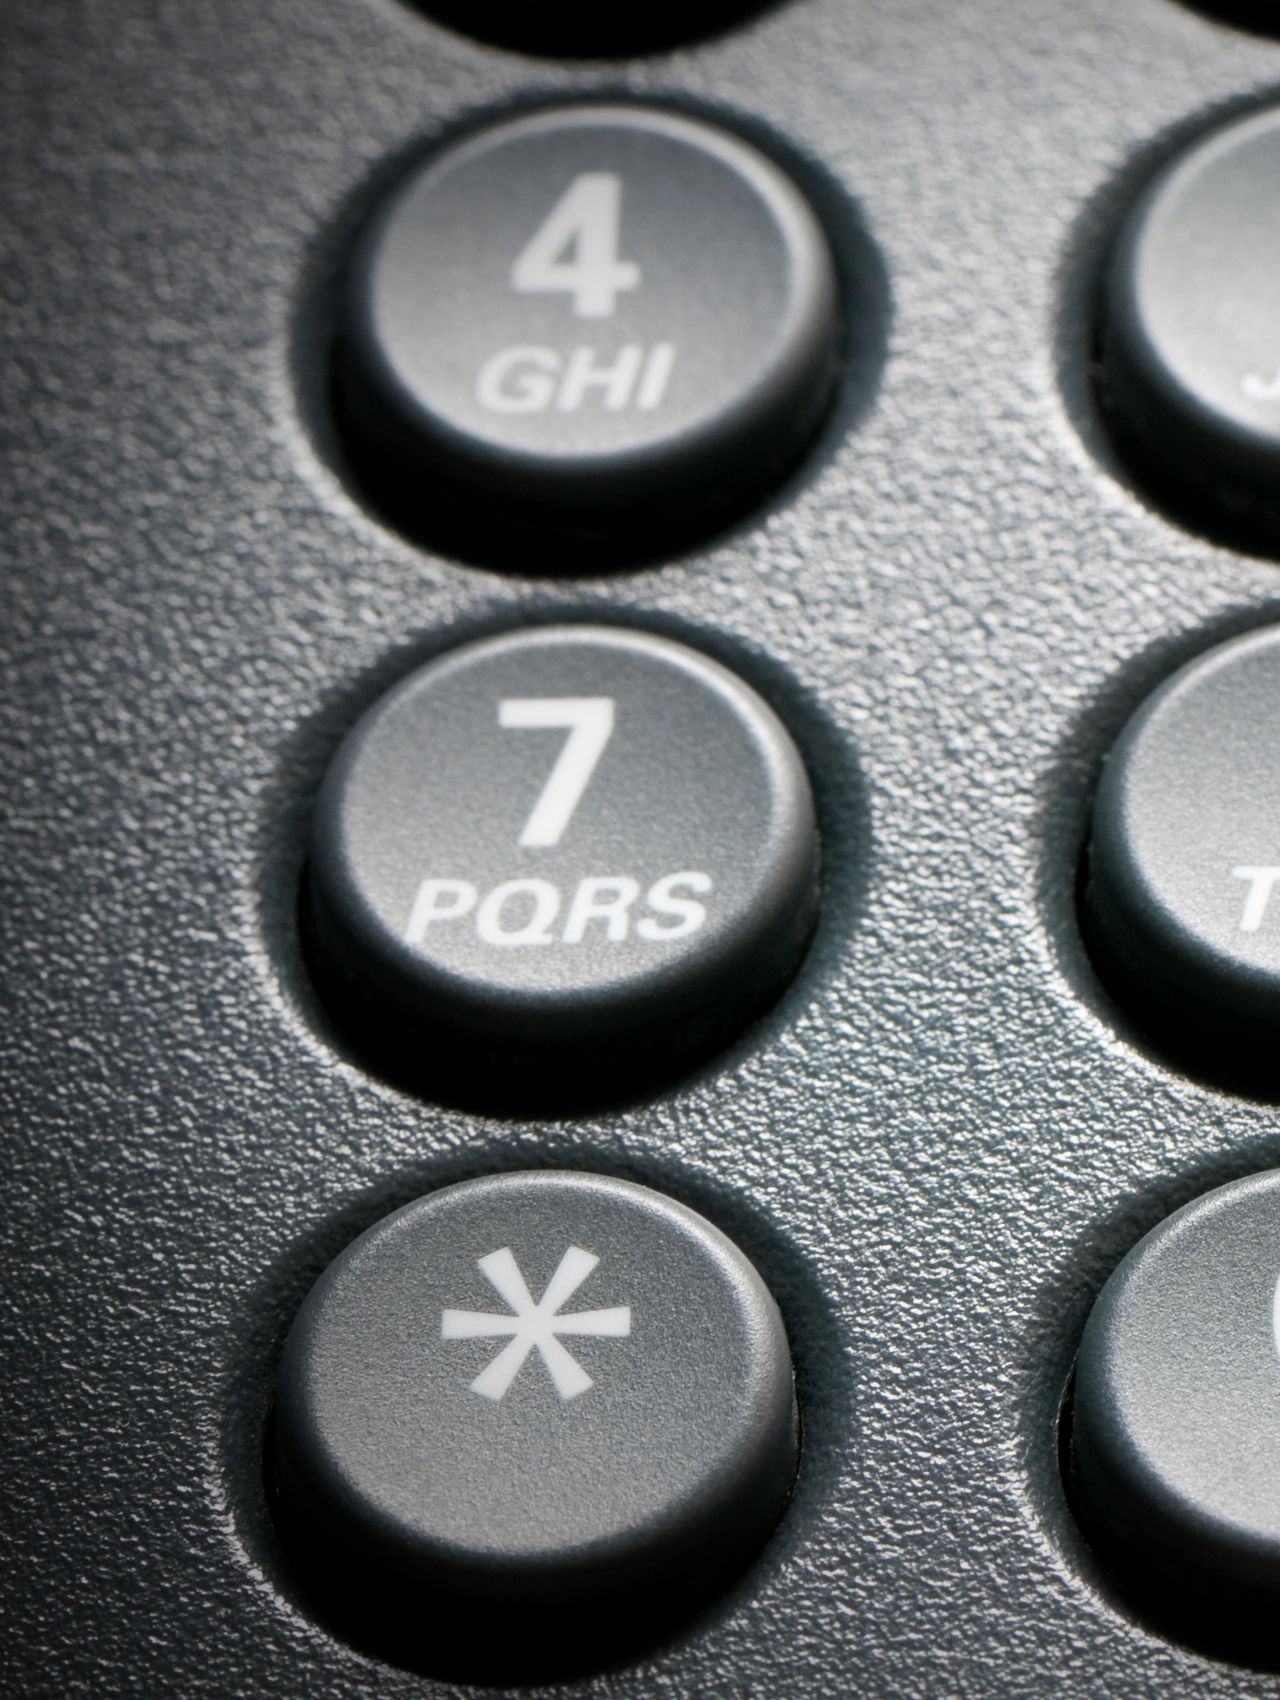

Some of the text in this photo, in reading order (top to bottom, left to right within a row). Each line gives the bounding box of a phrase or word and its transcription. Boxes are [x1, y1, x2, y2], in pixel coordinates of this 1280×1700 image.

[511, 173, 640, 318] 4
[475, 340, 674, 416] GHI
[496, 696, 617, 847] 7
[405, 870, 713, 950] PQRS
